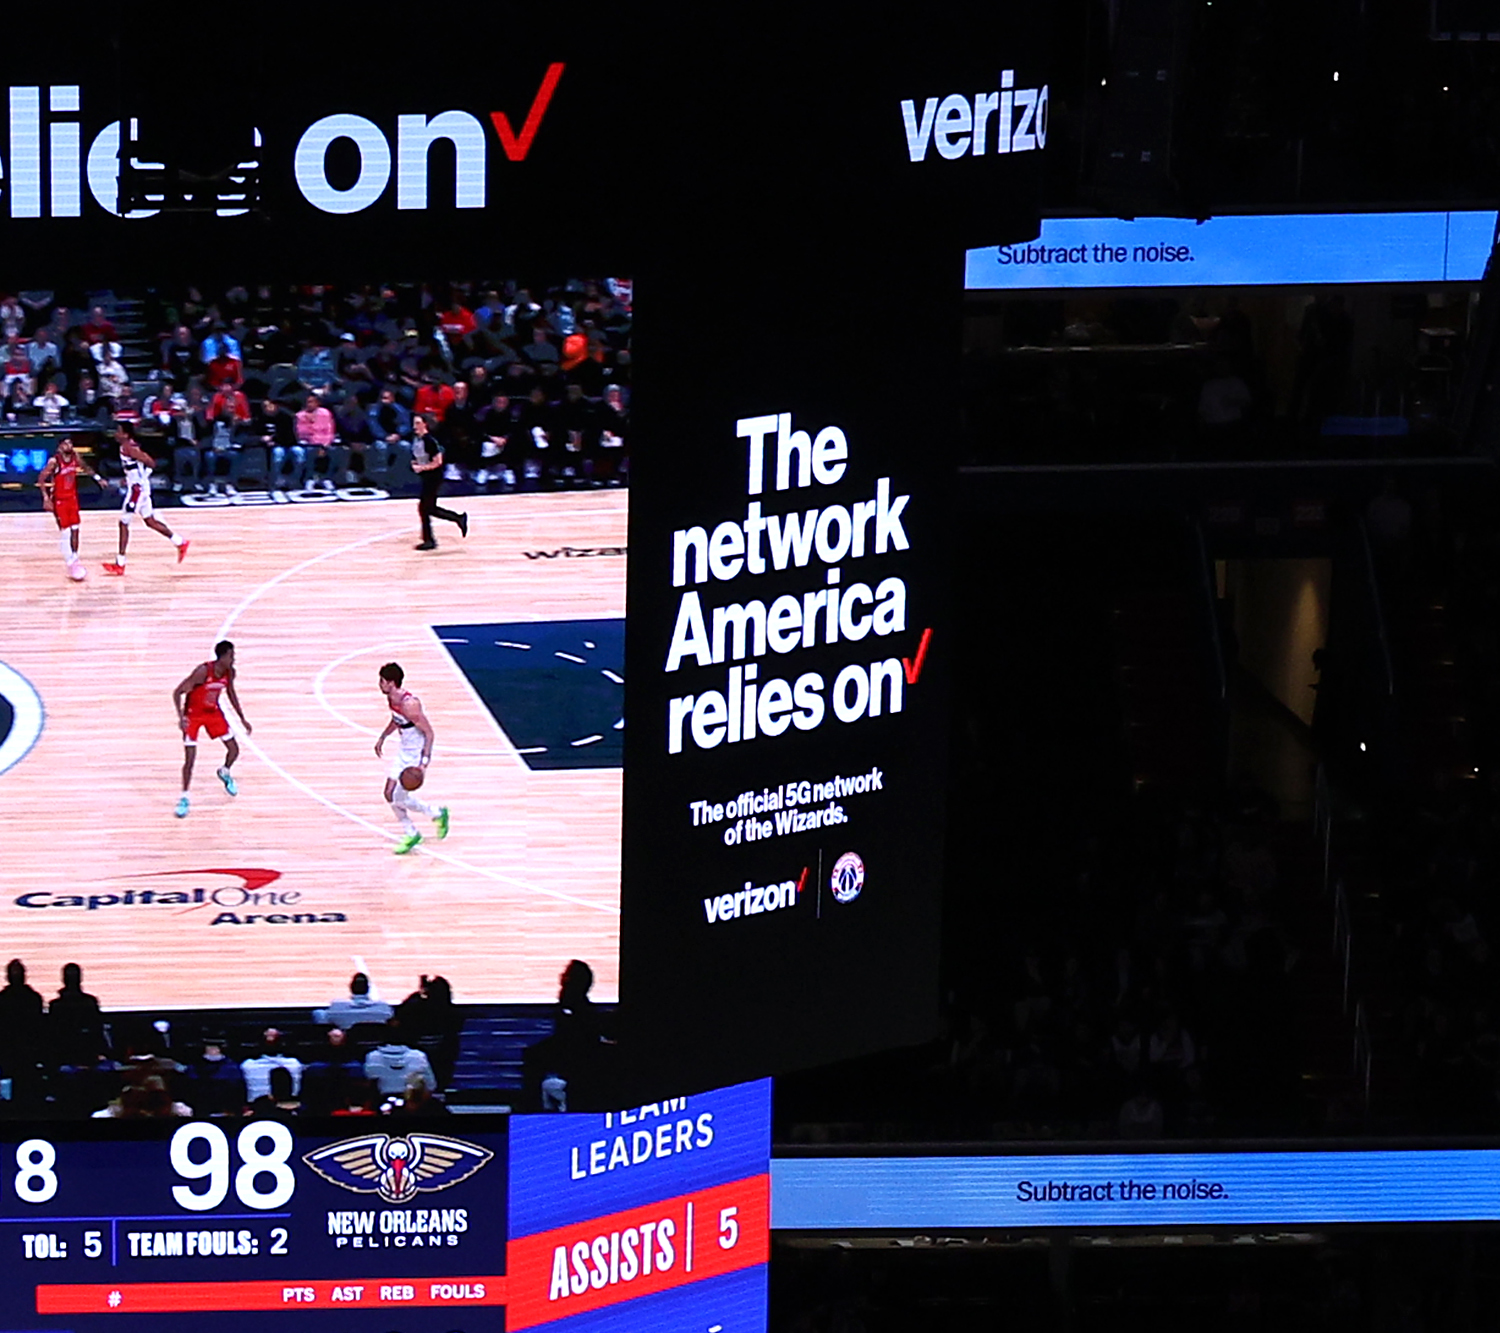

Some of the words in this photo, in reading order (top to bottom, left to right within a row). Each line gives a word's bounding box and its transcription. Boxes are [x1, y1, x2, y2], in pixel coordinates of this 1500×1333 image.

[294, 108, 486, 216] on
[737, 412, 848, 495] The
[673, 477, 910, 587] network
[665, 567, 906, 672] America
[668, 662, 824, 755] relies
[832, 657, 902, 723] on
[705, 878, 795, 923] verizon
[169, 1120, 296, 1211] 98
[571, 1113, 713, 1180] LEADERS
[22, 1233, 67, 1259] TOL:
[84, 1230, 102, 1258] 5
[127, 1231, 183, 1257] TEAM
[186, 1230, 259, 1256] FOULS:
[270, 1227, 288, 1255] 2
[327, 1210, 376, 1235] NEW
[379, 1208, 468, 1237] ORLEANS
[336, 1234, 458, 1248] PELICANS
[550, 1218, 675, 1301] ASSISTS
[718, 1207, 738, 1249] 5
